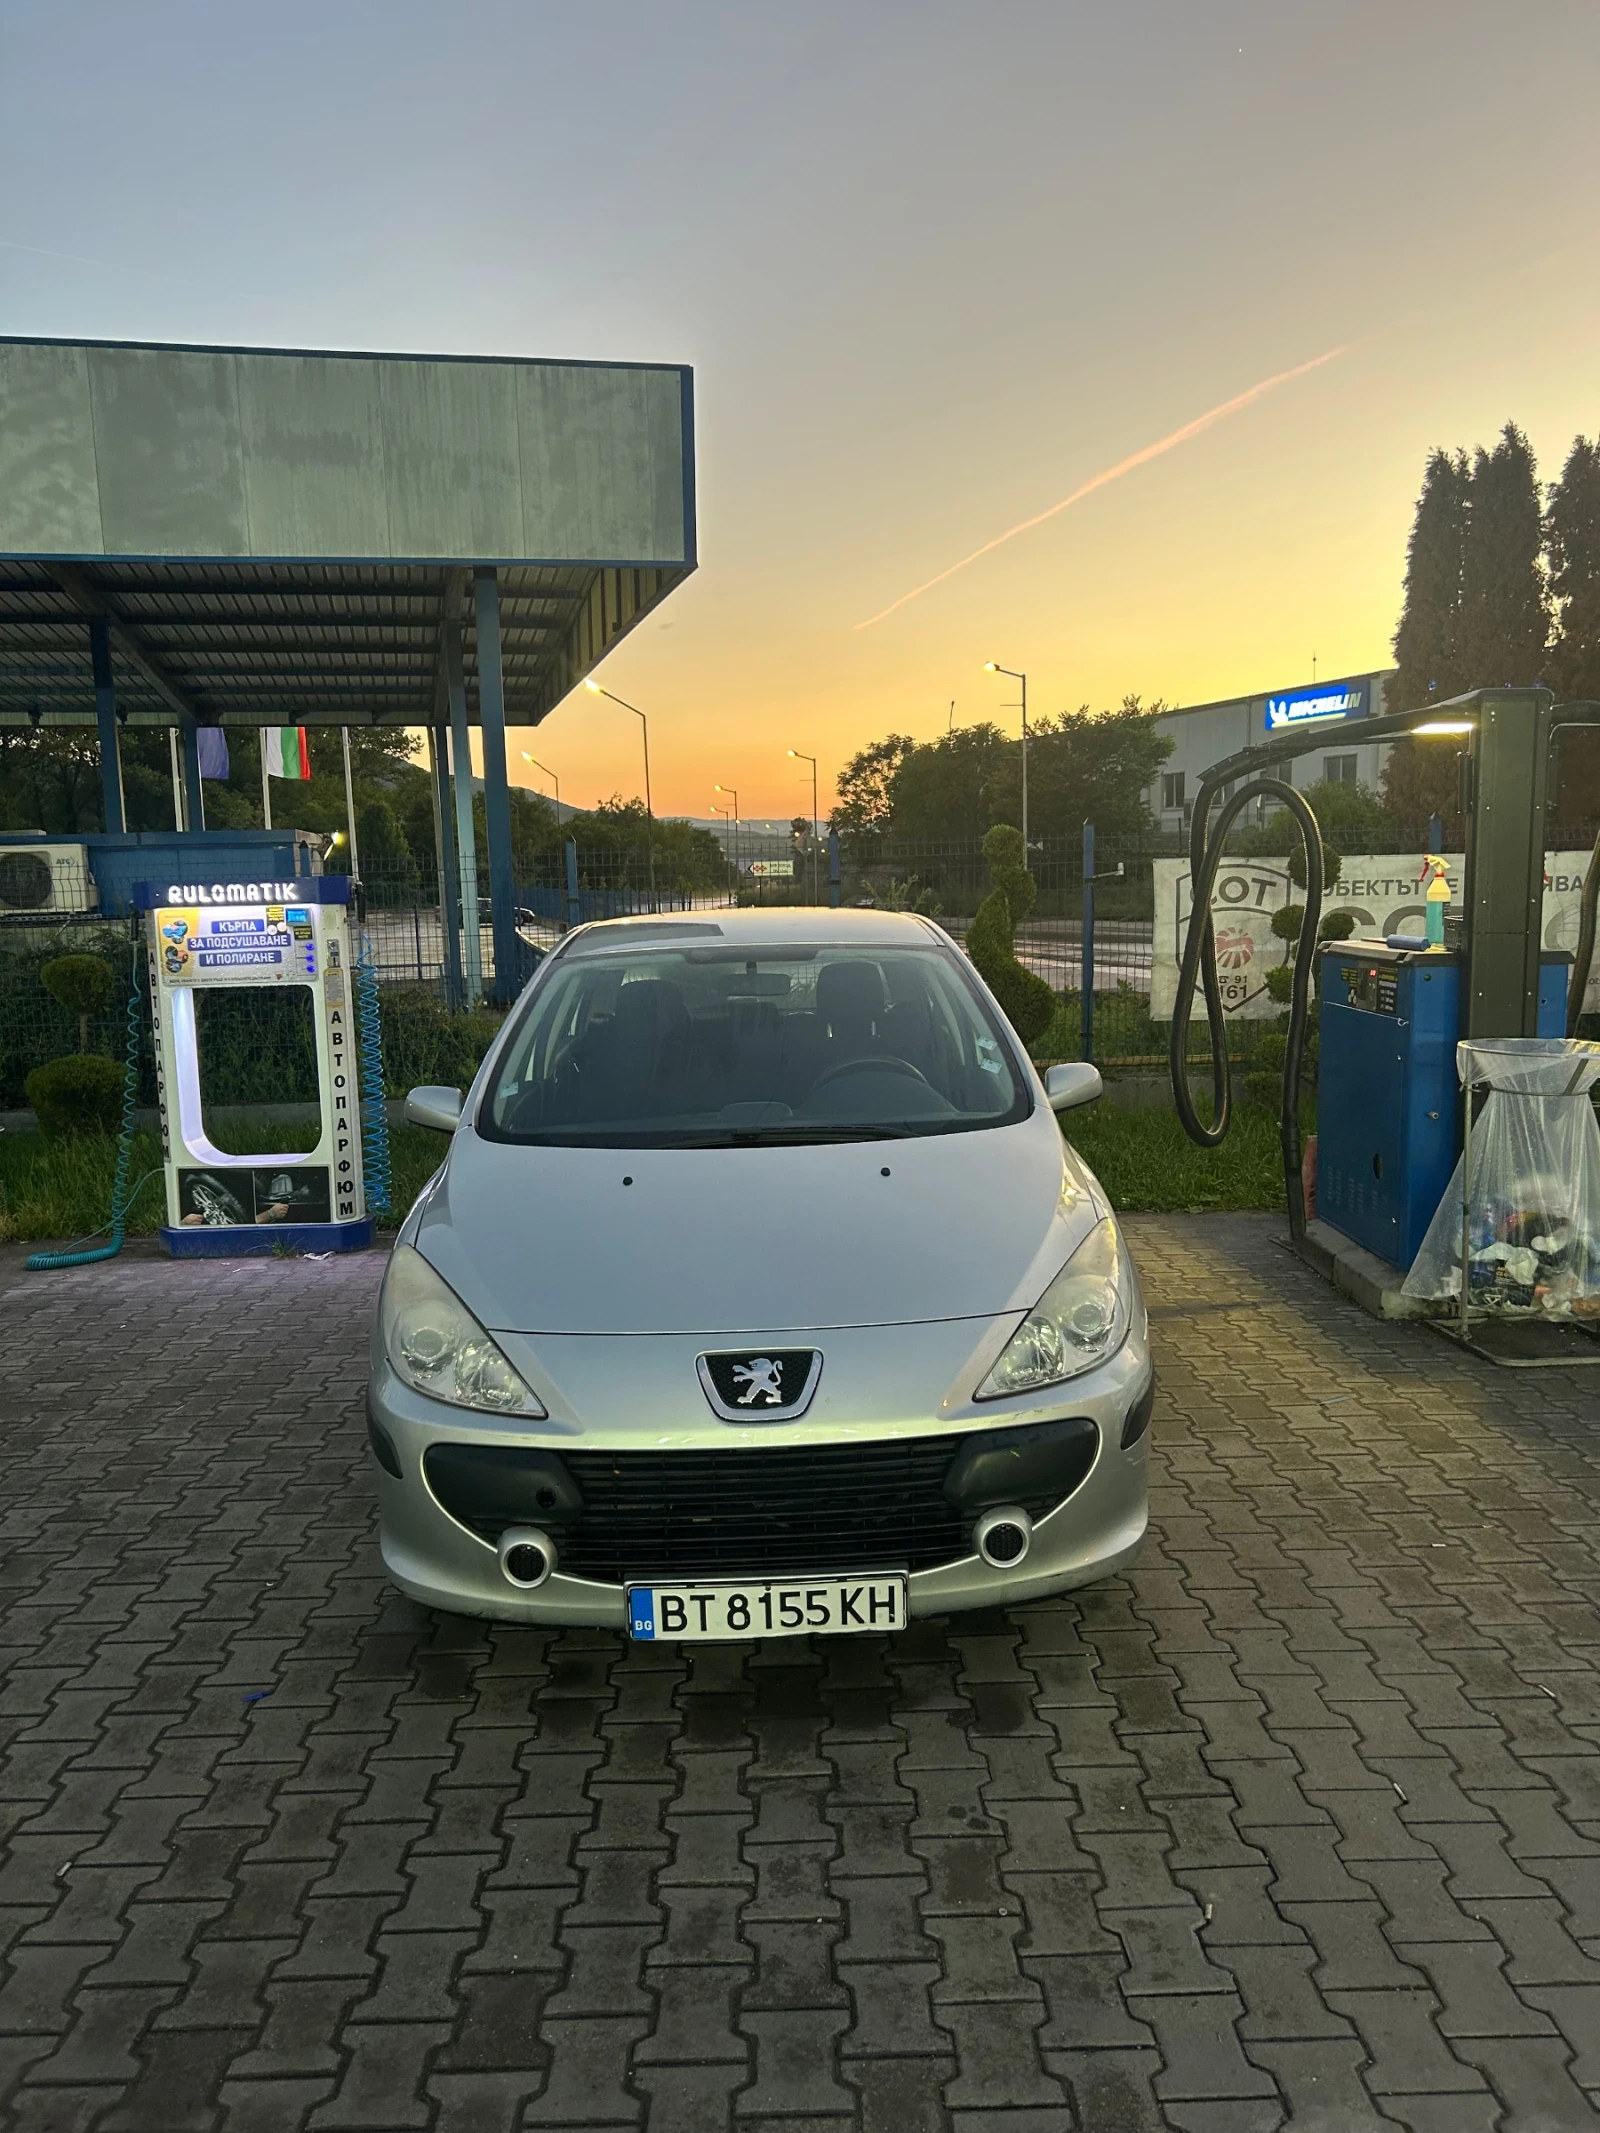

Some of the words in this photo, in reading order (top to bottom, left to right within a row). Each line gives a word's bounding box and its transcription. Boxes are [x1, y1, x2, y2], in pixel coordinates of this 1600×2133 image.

[1288, 692, 1362, 718] MICHELIN
[1190, 876, 1277, 906] ОТ
[219, 921, 257, 932] КЪРПА
[190, 939, 204, 949] ЗА
[206, 935, 288, 949] ПОДСУШАВАНЕ
[205, 954, 214, 965] И
[216, 952, 275, 964] ПОЛИРАНЕ
[1234, 975, 1247, 984] 91
[331, 1010, 354, 1216] АВТОПАРФЮМ
[660, 1594, 716, 1633] BT
[726, 1590, 831, 1631] 8155
[840, 1585, 896, 1626] KH
[634, 1620, 653, 1631] BG
